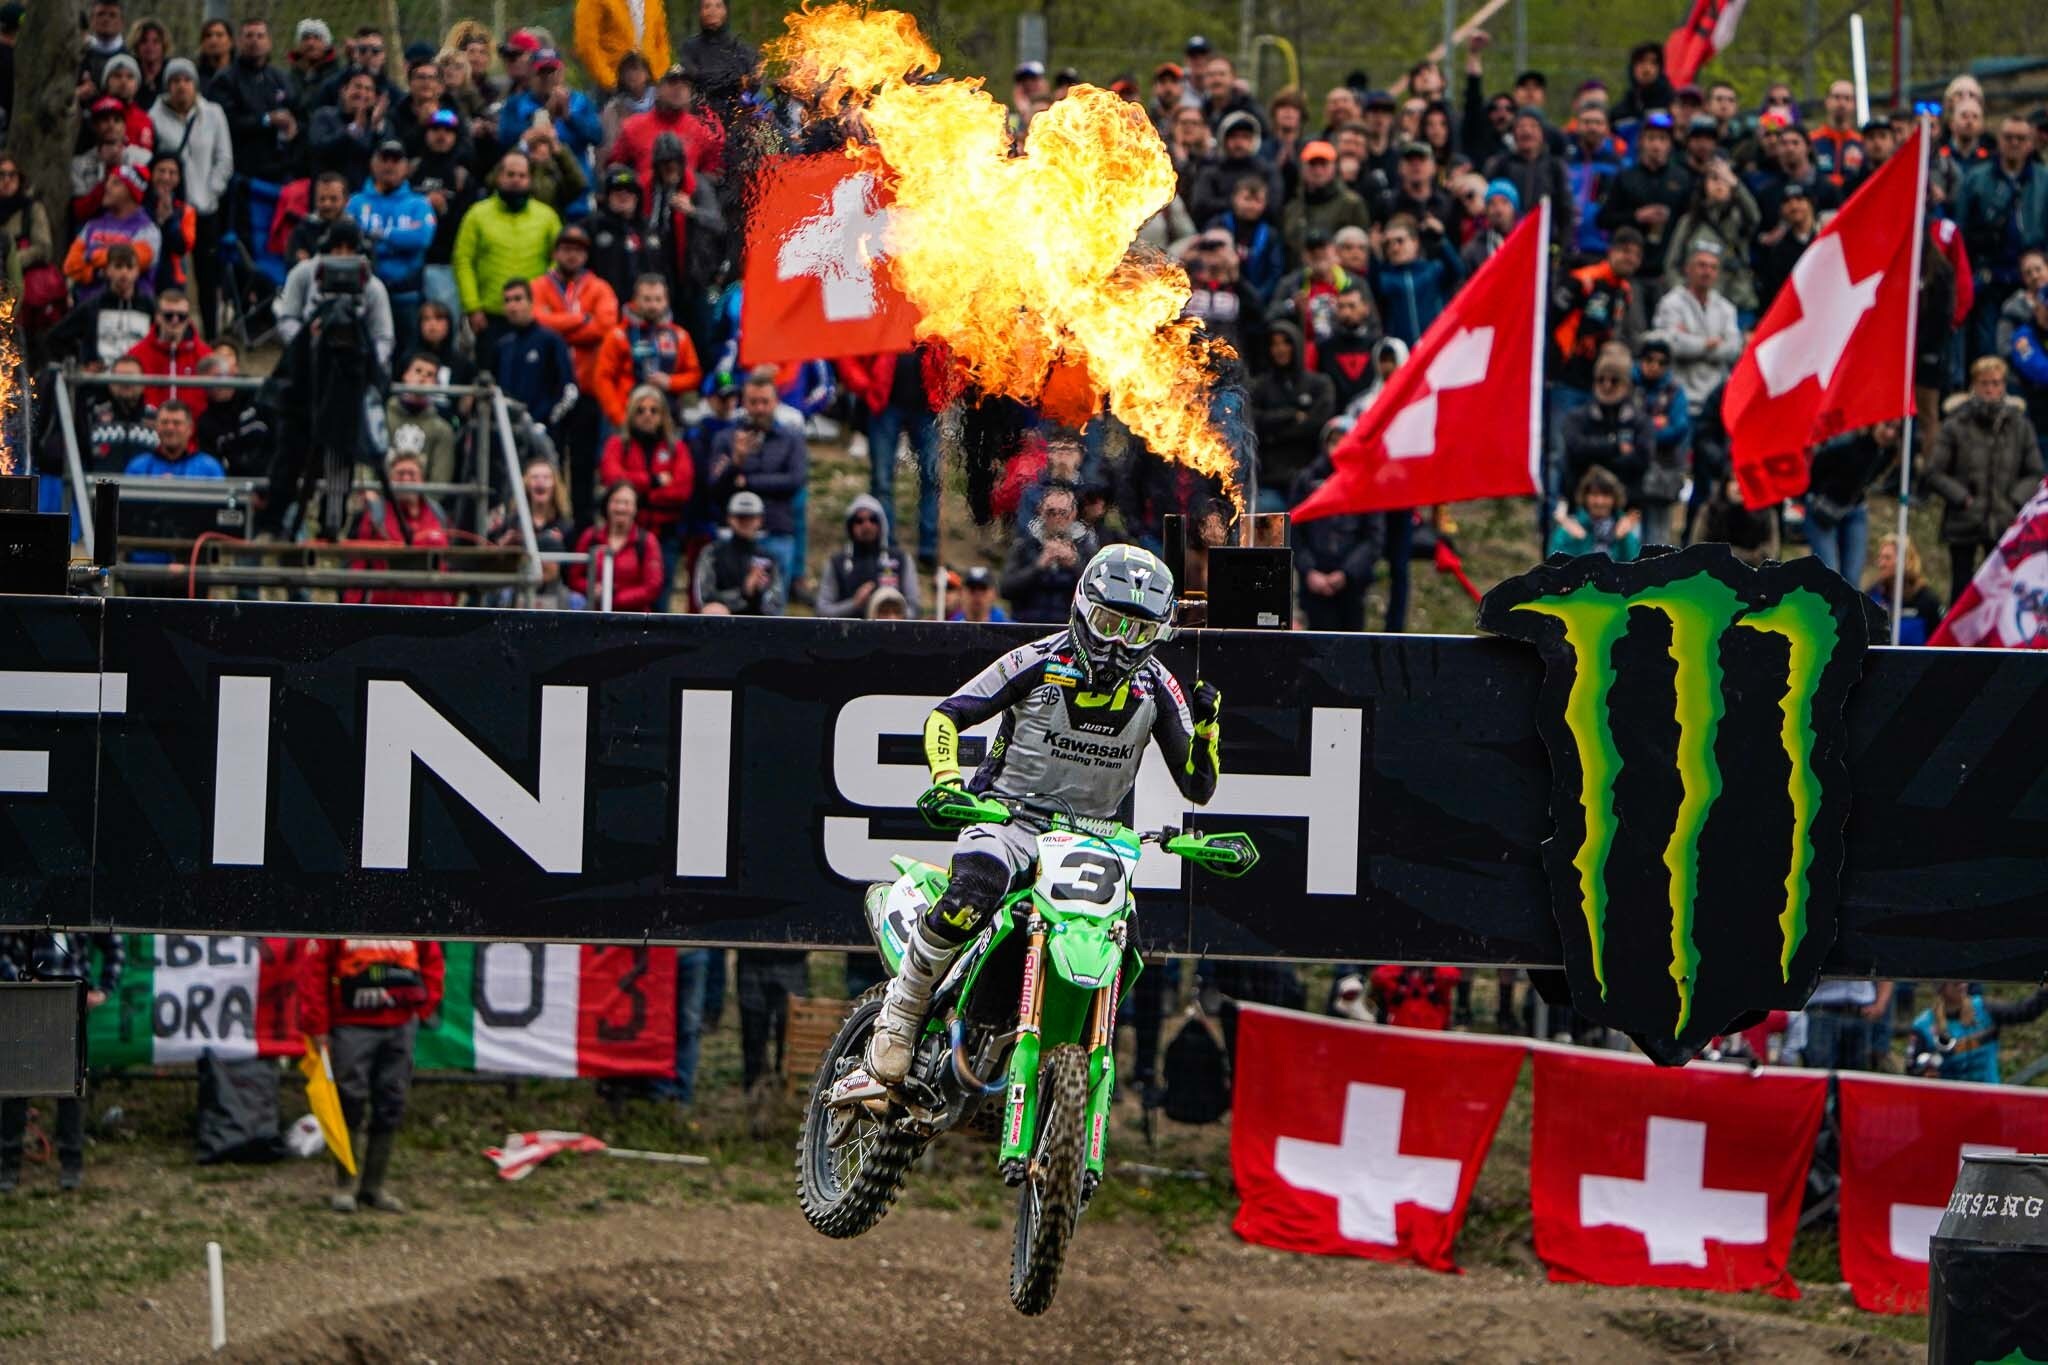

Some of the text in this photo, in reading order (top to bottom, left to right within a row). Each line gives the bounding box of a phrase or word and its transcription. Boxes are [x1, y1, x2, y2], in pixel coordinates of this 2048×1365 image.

[1079, 722, 1115, 735] JUST1
[1042, 729, 1136, 760] Kawasaki
[1050, 748, 1122, 769] Racing Team
[1050, 851, 1121, 905] 3
[118, 983, 304, 1044] FORAT
[1946, 1192, 2044, 1219] INSENG
